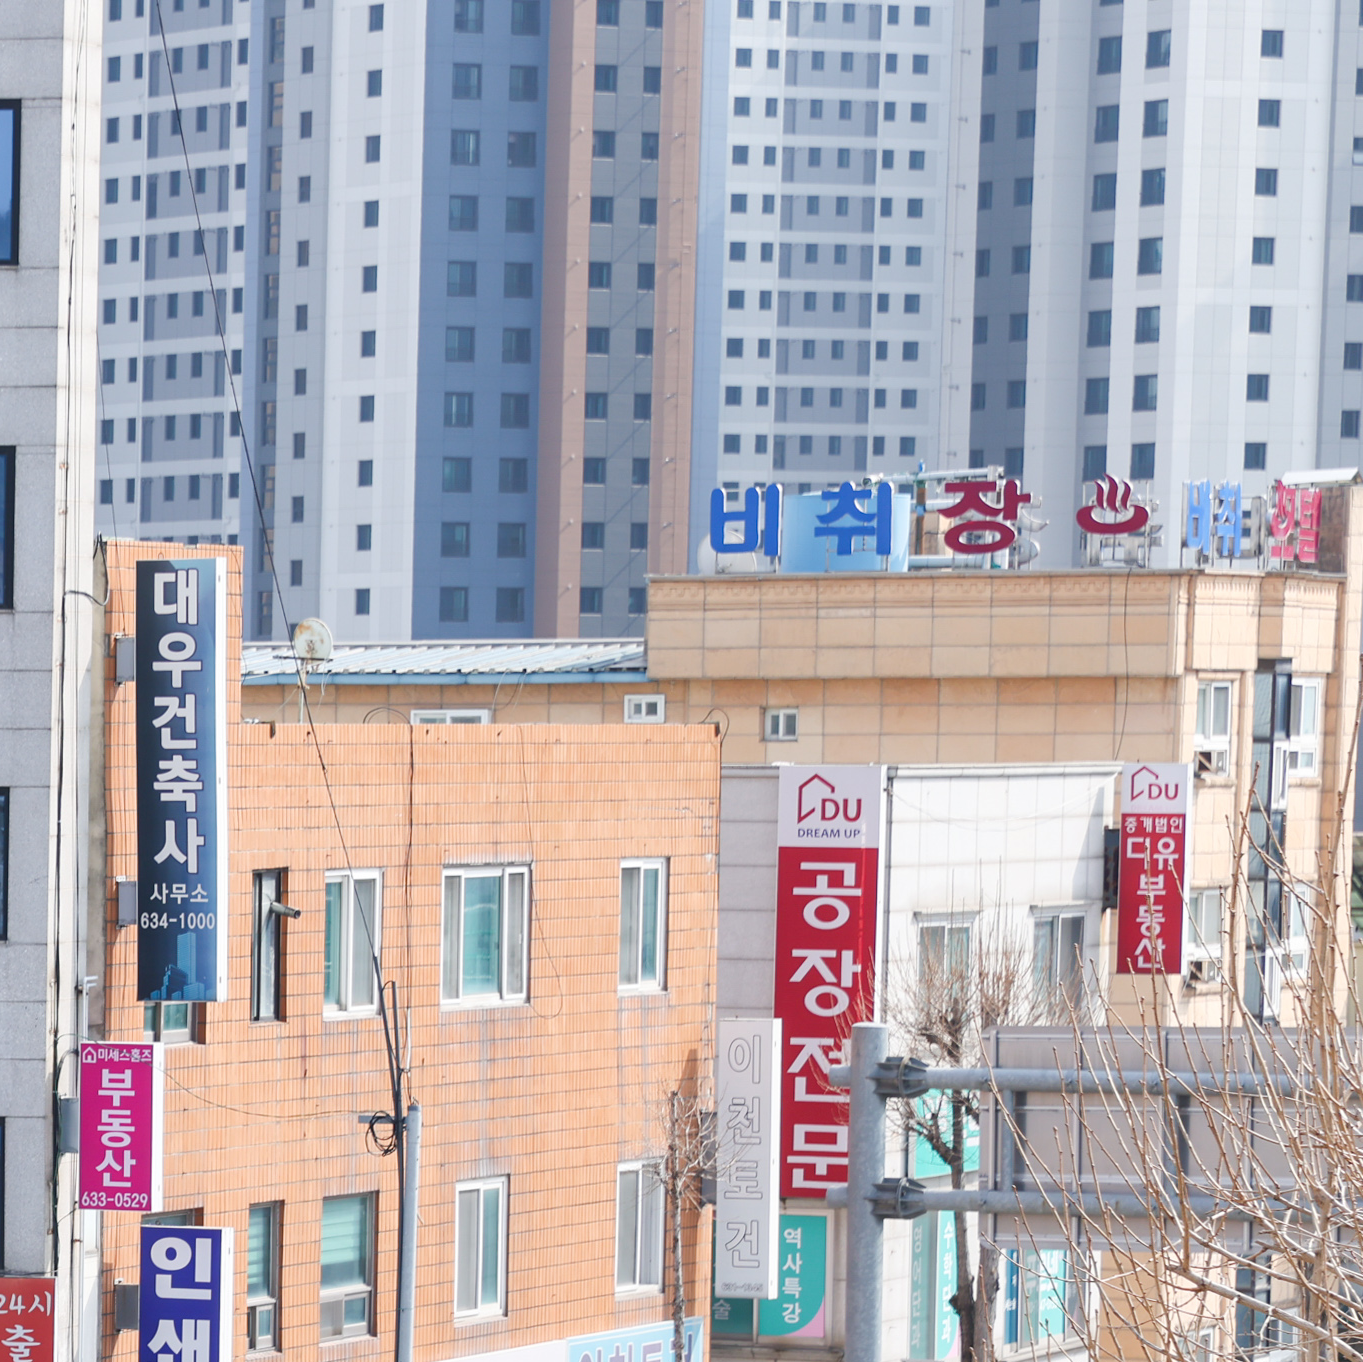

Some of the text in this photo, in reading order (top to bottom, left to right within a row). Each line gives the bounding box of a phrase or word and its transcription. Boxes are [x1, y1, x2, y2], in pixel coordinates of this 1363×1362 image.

[710, 480, 1032, 556] 비취장
[1186, 481, 1241, 557] 비취
[151, 568, 205, 874] 대우건축사
[1149, 783, 1179, 801] DU
[820, 798, 863, 824] DU
[797, 828, 861, 839] DREAM UP
[150, 883, 209, 904] 사무소
[140, 912, 215, 929] 634-1000
[97, 1048, 152, 1063] 미세스홈즈
[95, 1068, 136, 1188] 부동산
[723, 1034, 764, 1270] 이천토건
[81, 1192, 149, 1209] 633-0529
[782, 1227, 803, 1324] 역사특강
